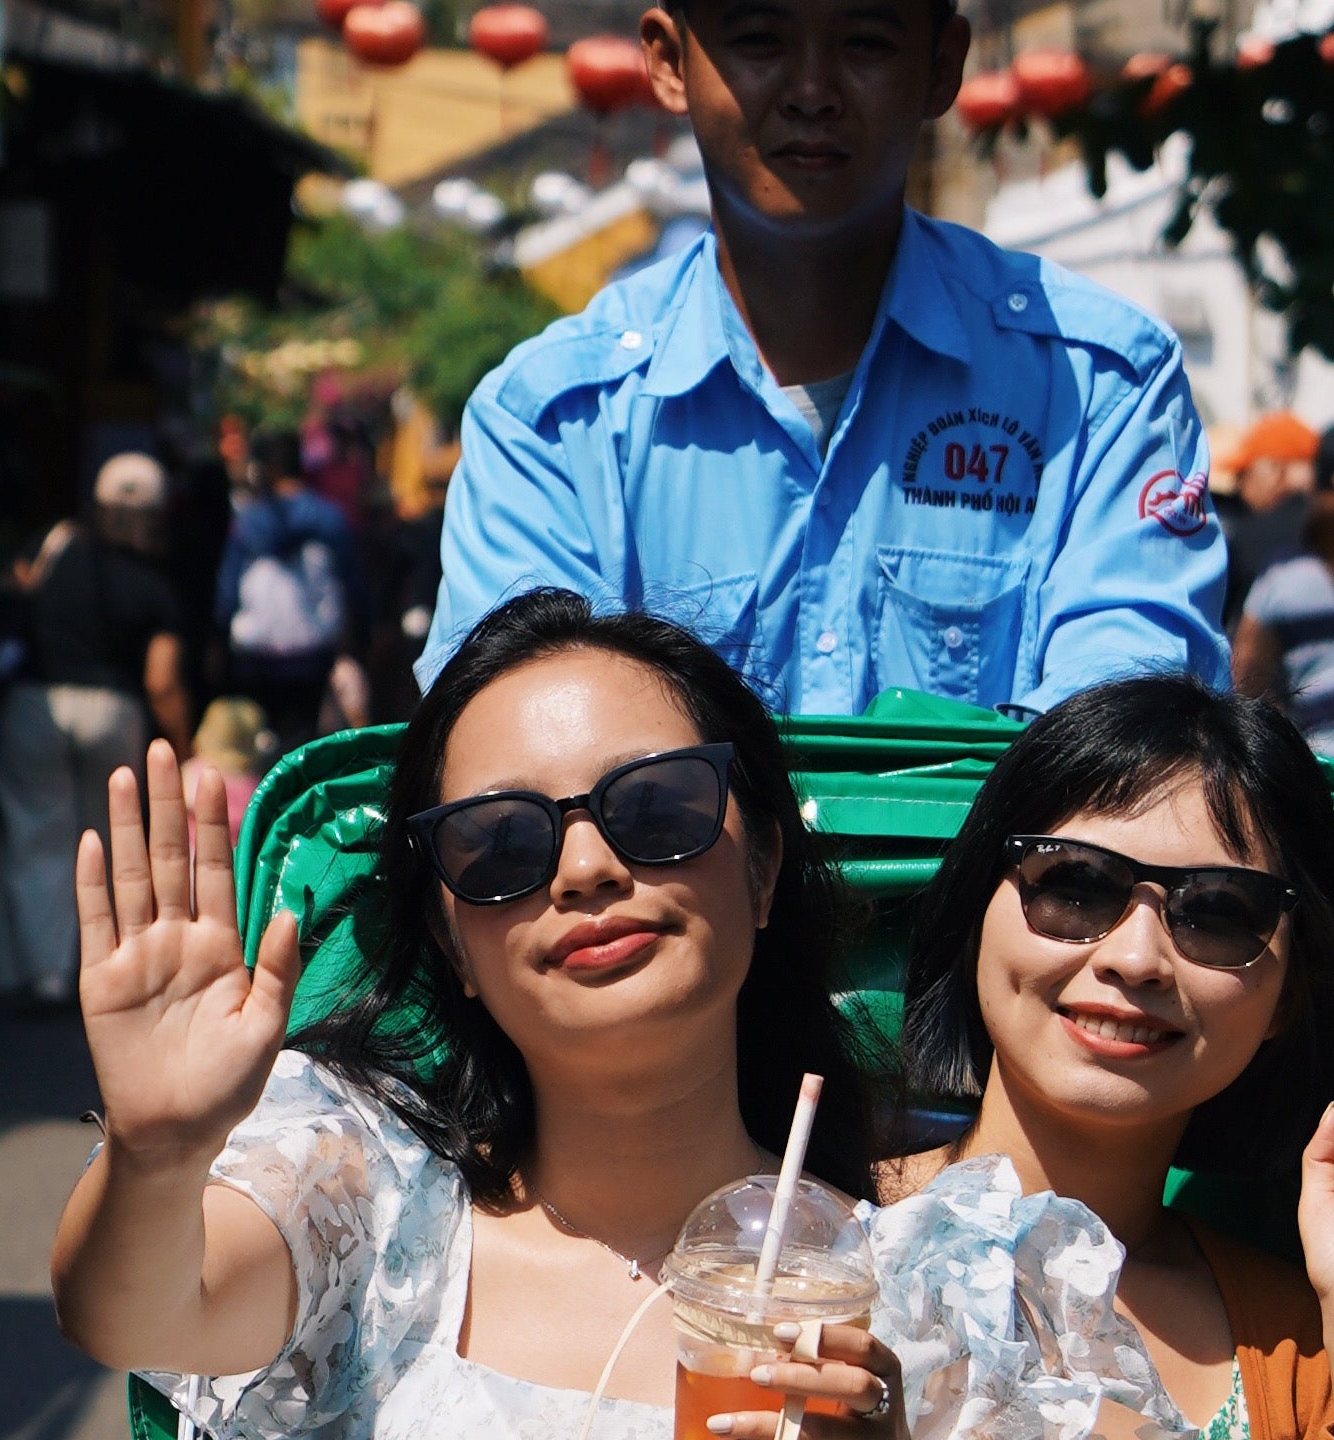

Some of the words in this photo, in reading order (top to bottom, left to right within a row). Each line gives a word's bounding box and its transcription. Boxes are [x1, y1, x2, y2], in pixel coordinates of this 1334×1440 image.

[944, 442, 1009, 484] 047
[902, 486, 956, 508] THÀNH
[961, 488, 993, 511] PHỐ
[995, 492, 1020, 517] HỘI
